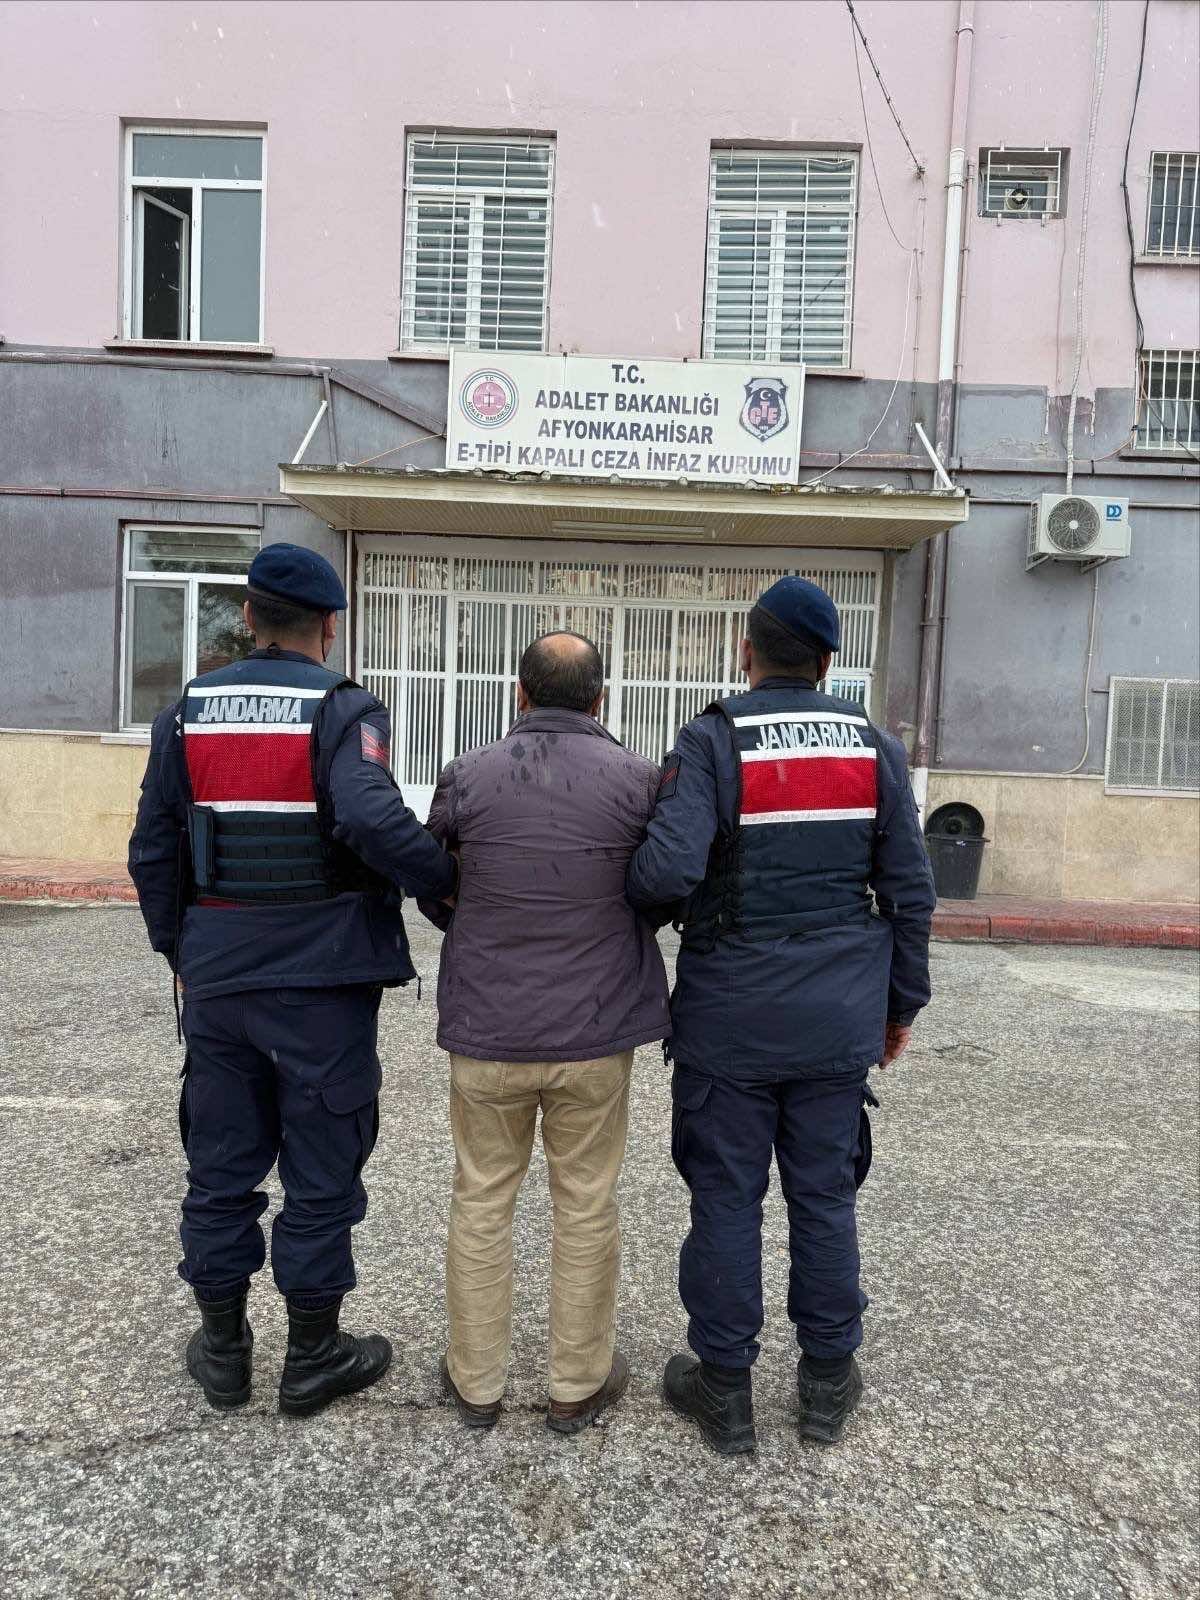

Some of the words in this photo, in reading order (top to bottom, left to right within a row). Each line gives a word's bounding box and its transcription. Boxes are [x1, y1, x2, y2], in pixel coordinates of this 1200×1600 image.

[612, 364, 645, 384] T.C.
[535, 390, 609, 411] ADALET
[615, 392, 719, 416] BAKANLIĞI
[538, 418, 713, 444] AFYONKARAHİSAR
[457, 440, 511, 464] E-TİPİ
[518, 446, 585, 468] KAPALI
[591, 449, 640, 470] CEZA
[647, 447, 701, 473] İNFAZ
[707, 455, 792, 476] KURUMU
[198, 696, 302, 723] JANDARMA
[755, 722, 865, 750] JANDARMA
